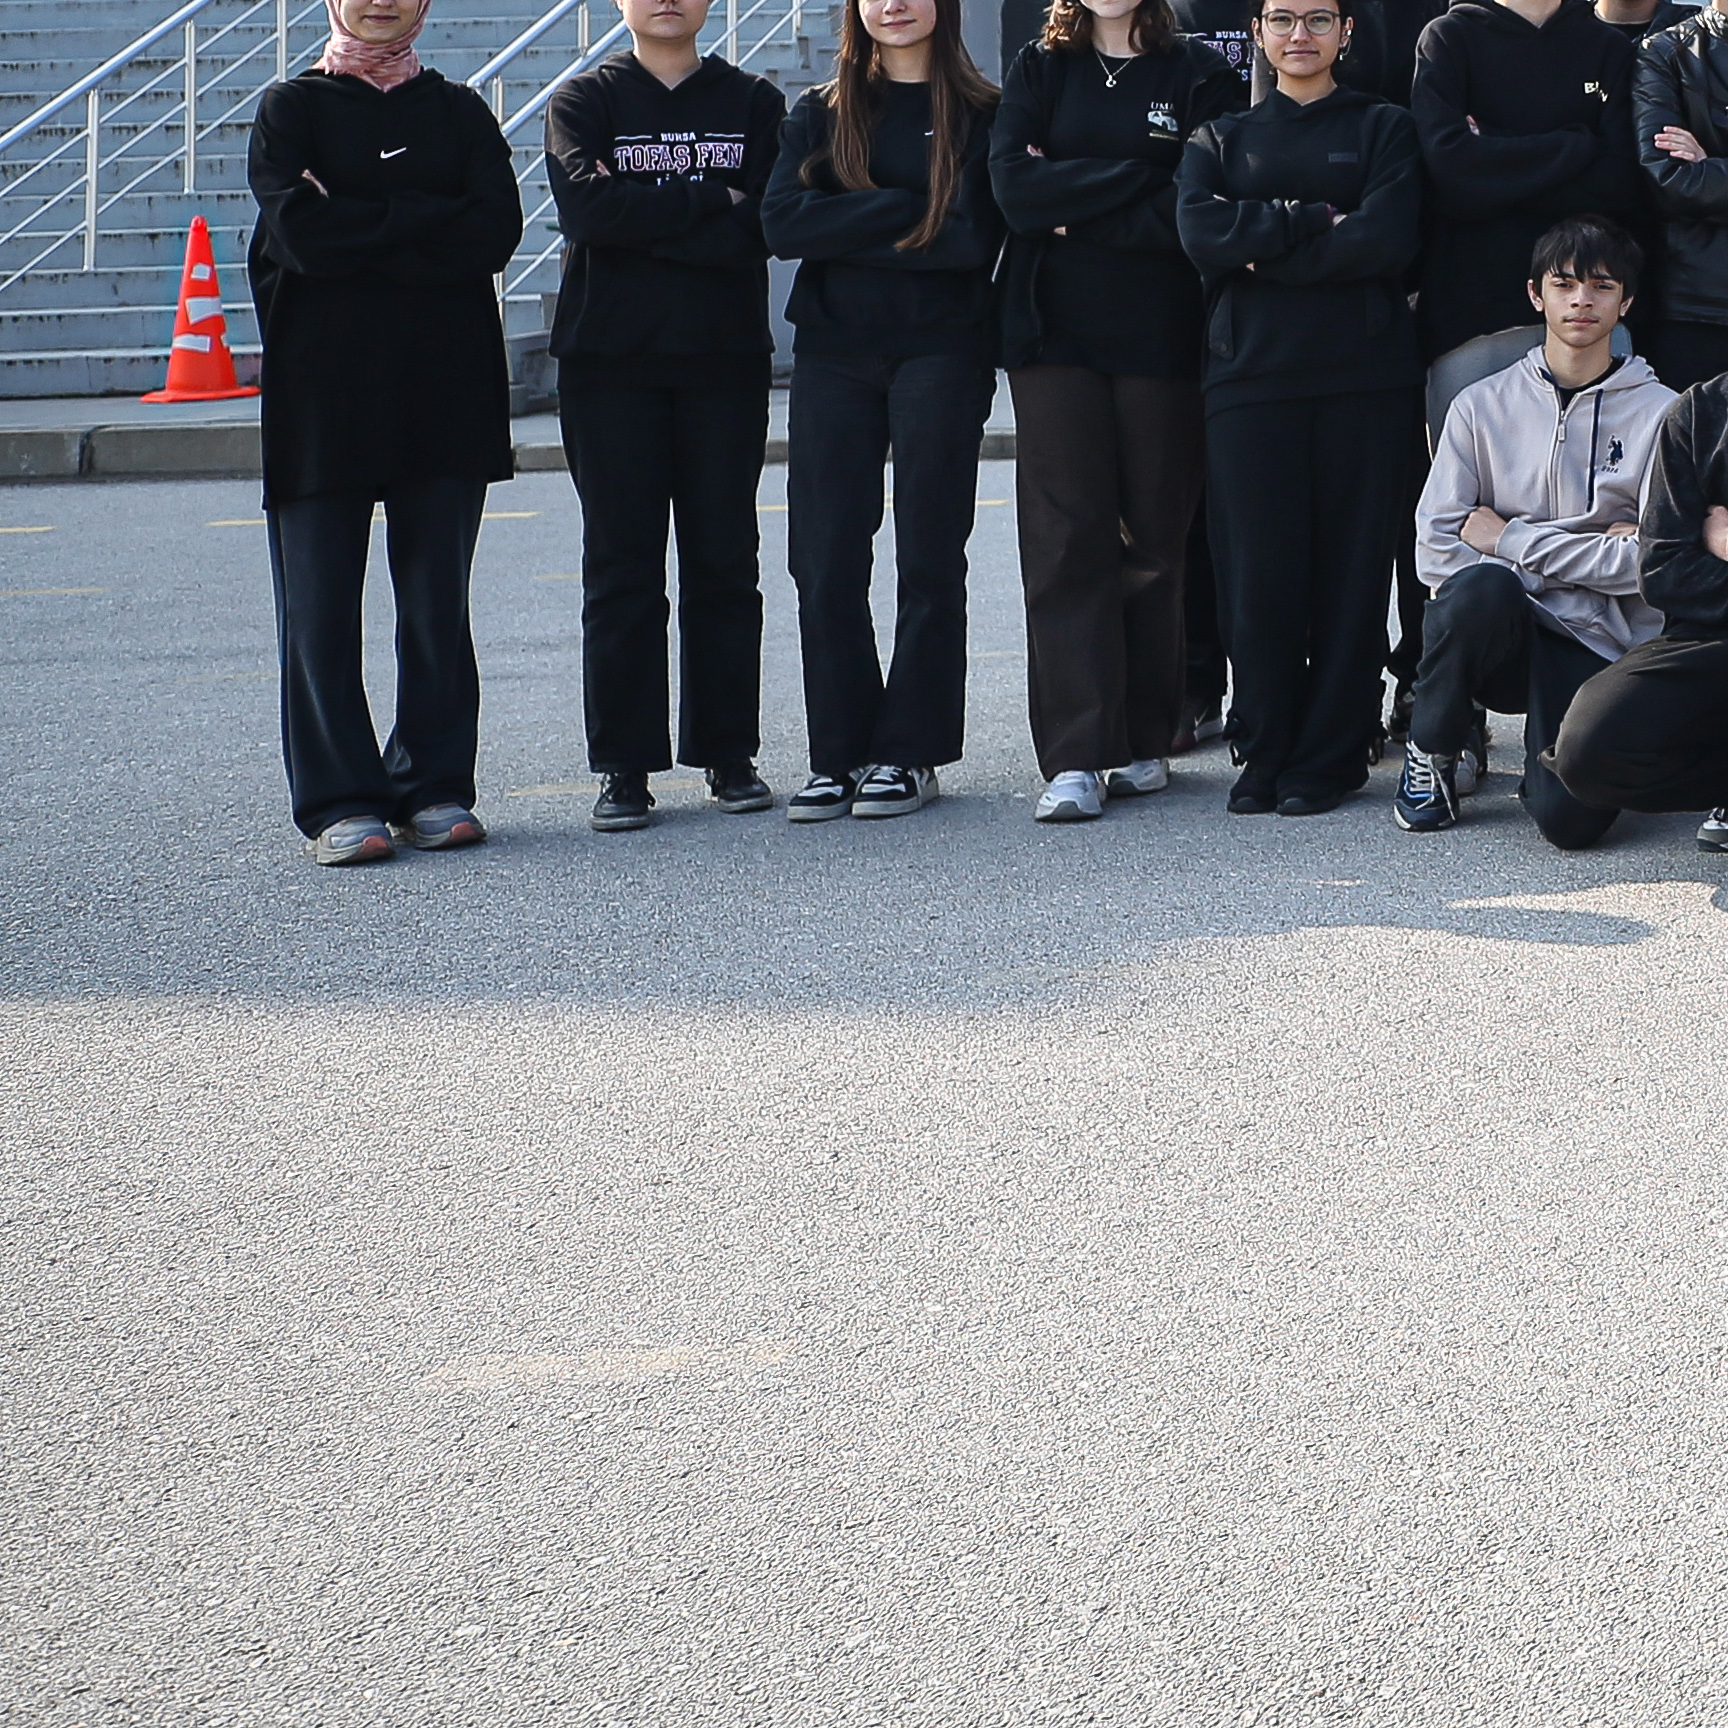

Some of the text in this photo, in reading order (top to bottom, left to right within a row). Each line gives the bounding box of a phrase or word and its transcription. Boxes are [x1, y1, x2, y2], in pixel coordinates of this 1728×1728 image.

[1215, 31, 1248, 39] BURSA
[661, 132, 697, 142] BURSA
[614, 142, 744, 174] TOFAŞ FEN
